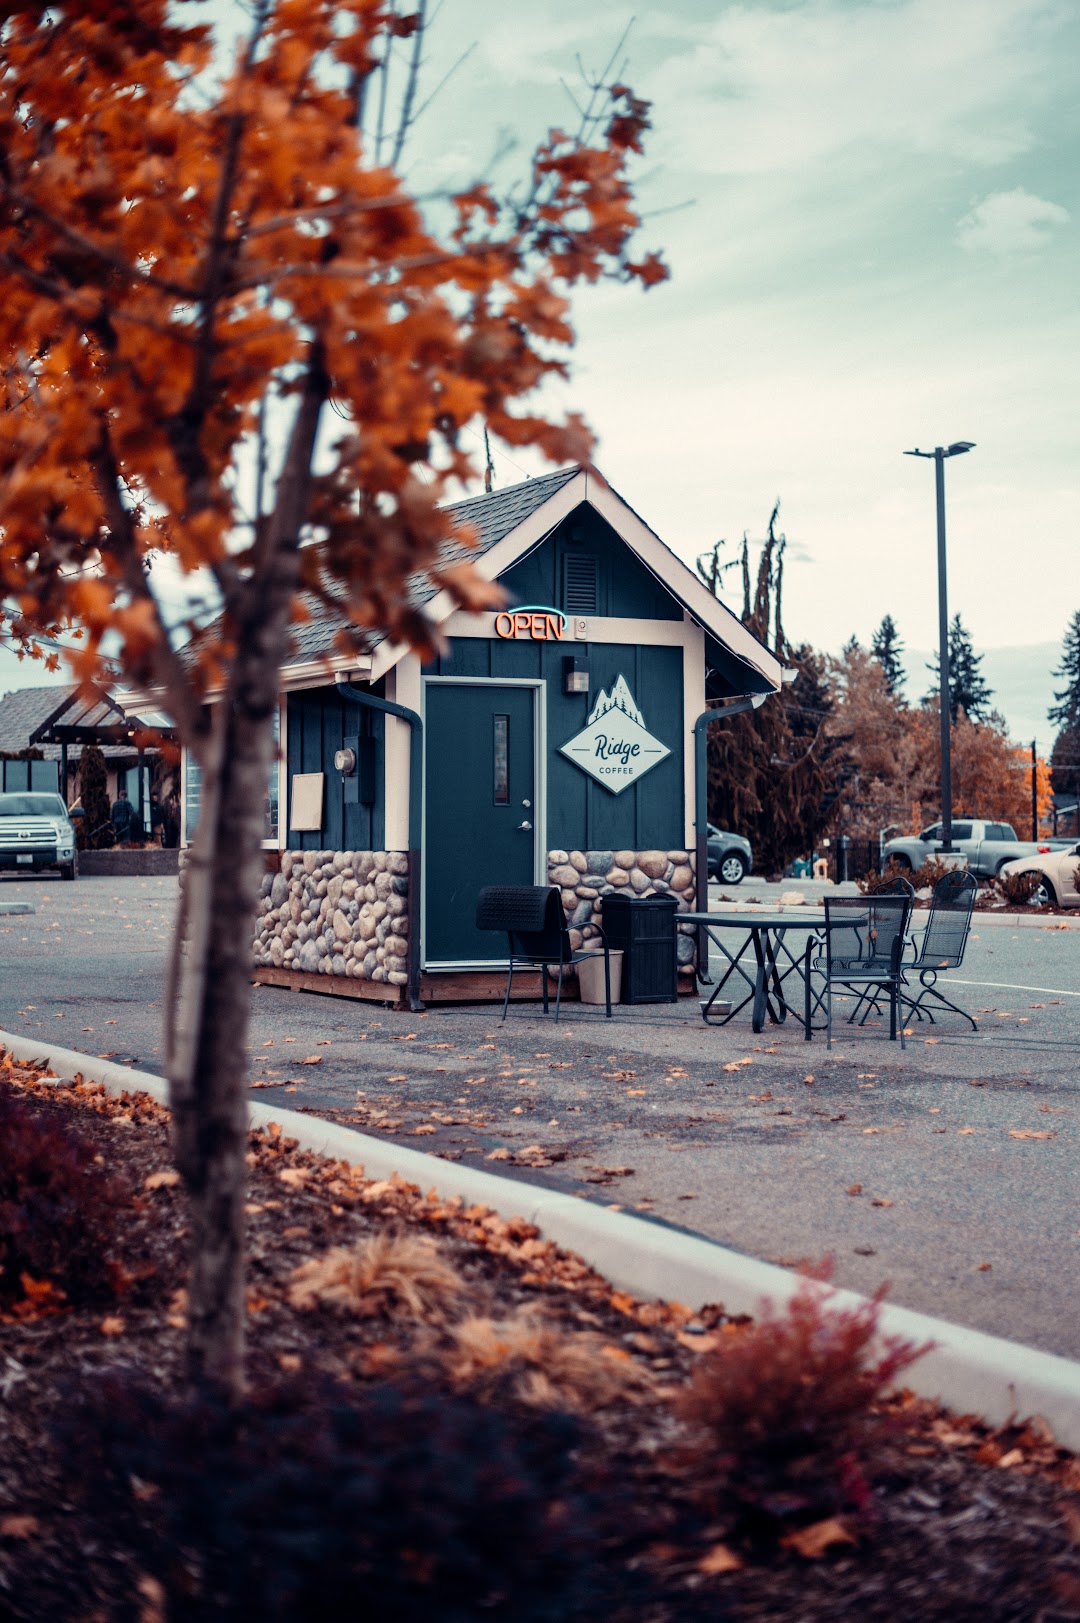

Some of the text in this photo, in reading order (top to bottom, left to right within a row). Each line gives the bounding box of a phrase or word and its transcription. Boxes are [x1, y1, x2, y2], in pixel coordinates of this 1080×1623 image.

[495, 612, 563, 640] OPEN
[594, 734, 641, 765] Ridge
[599, 767, 634, 775] COFFEE
